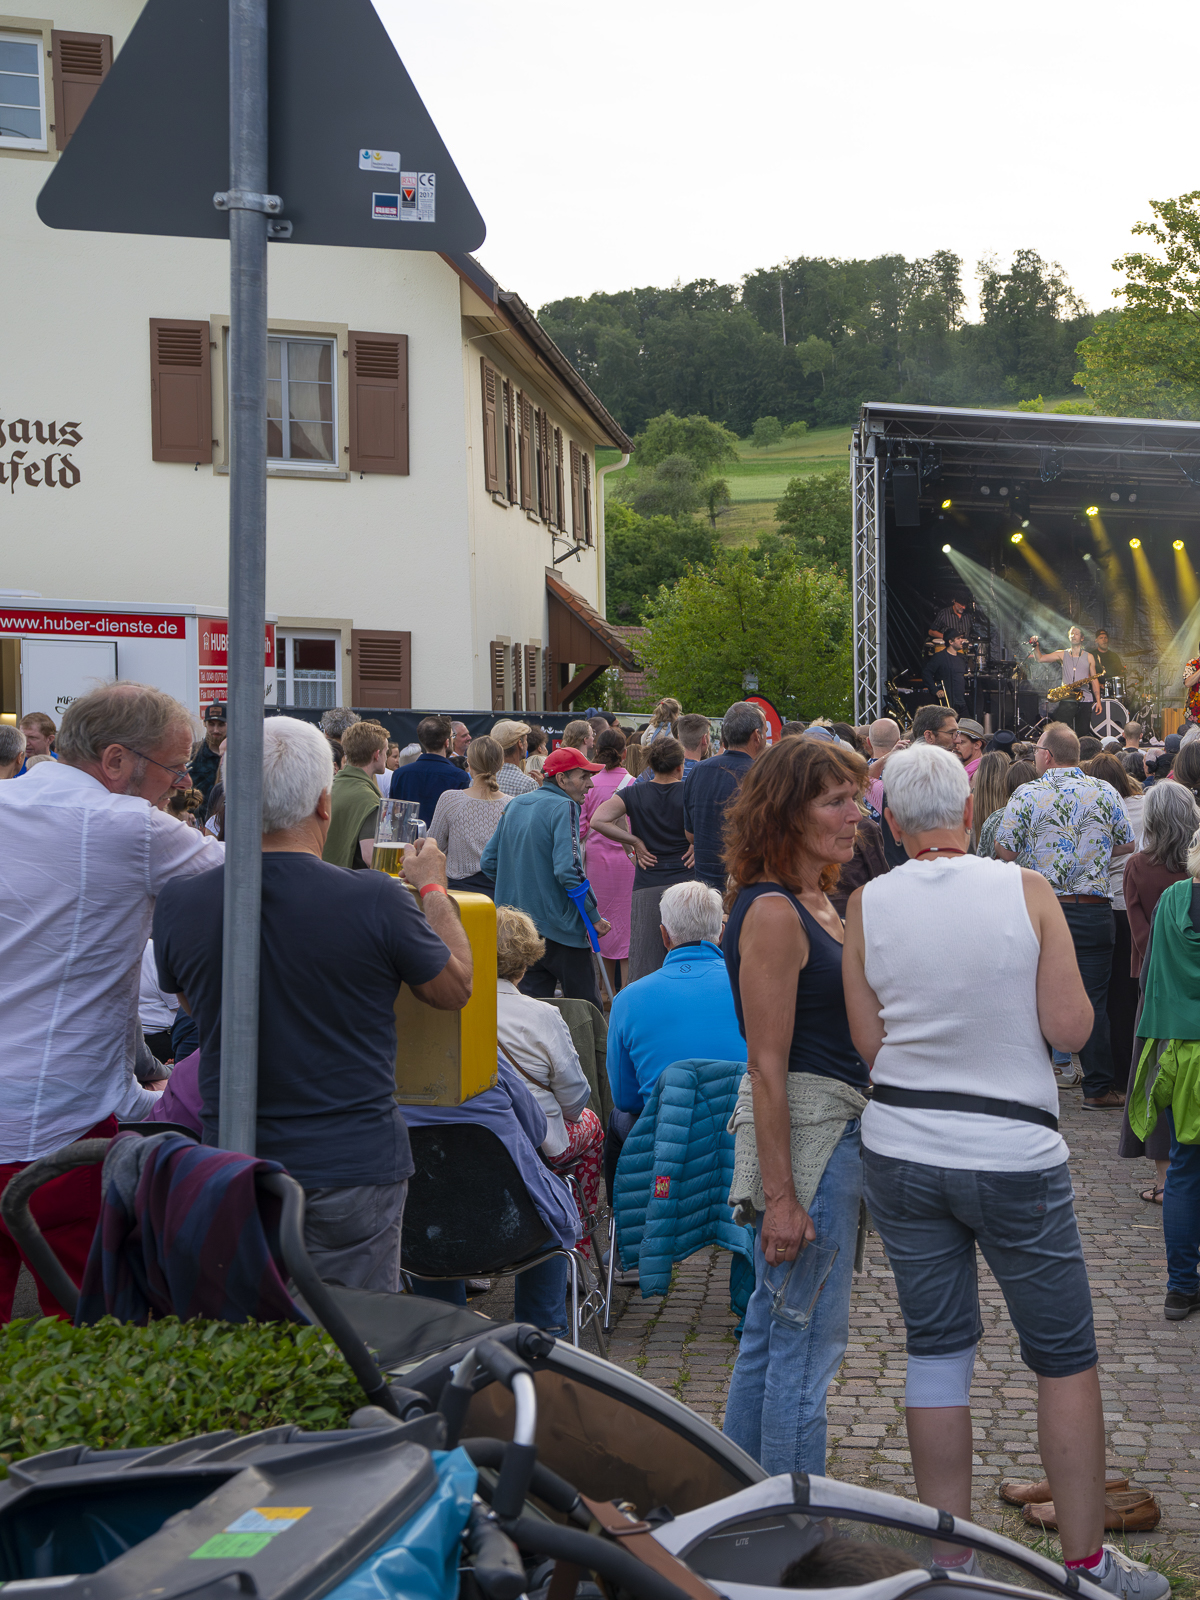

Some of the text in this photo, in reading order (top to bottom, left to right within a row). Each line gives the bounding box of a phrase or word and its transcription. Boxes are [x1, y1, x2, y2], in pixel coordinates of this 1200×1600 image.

[375, 206, 397, 214] RIES
[0, 418, 83, 448] aus
[0, 616, 178, 635] www.huber-dienste.de
[735, 1537, 750, 1546] LITE
